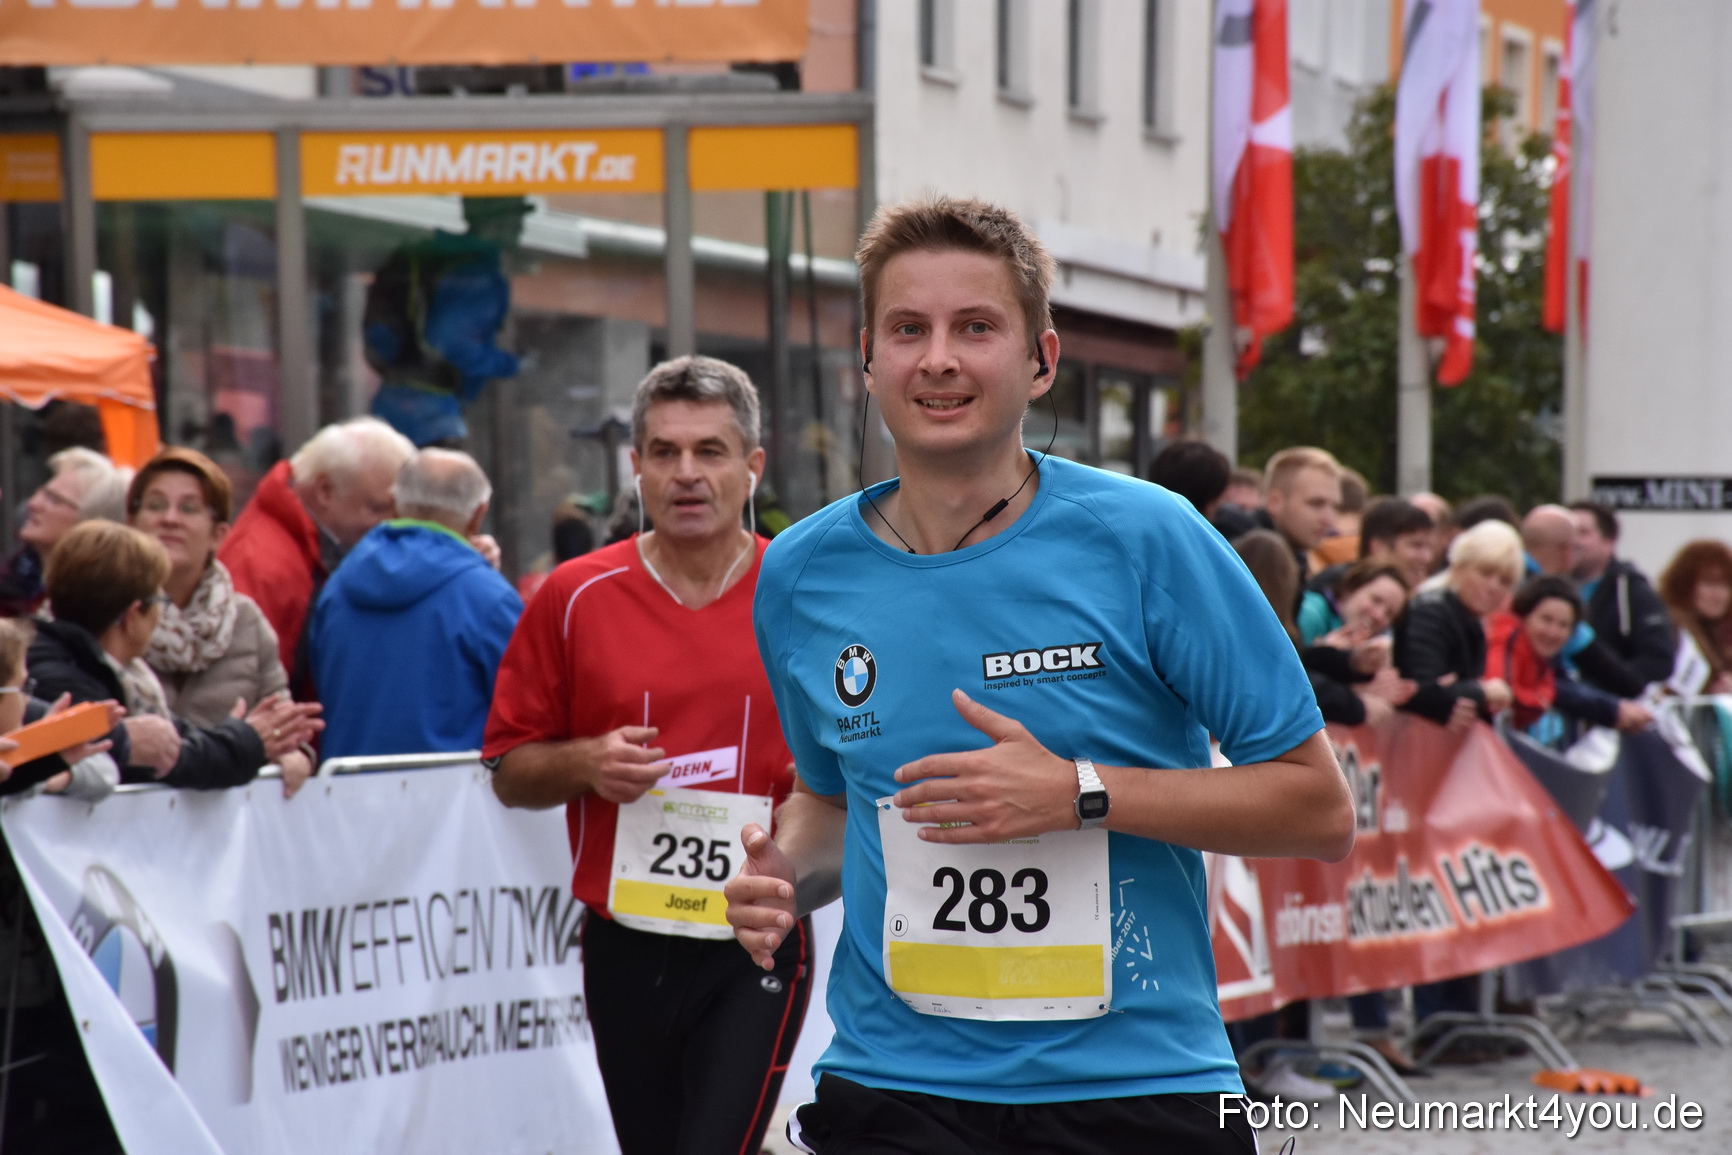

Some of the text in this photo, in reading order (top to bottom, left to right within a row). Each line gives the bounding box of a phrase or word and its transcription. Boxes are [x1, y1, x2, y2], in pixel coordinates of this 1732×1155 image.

[335, 141, 637, 185] RUNMARKT.DE
[837, 646, 873, 671] BMW
[984, 644, 1102, 678] BOCK
[984, 670, 1107, 690] inspired by smart concepts
[837, 711, 880, 733] PARTL
[839, 726, 882, 744] Neumarkt
[672, 760, 712, 778] DEHN
[649, 833, 731, 882] 235
[1441, 847, 1543, 921] Hits
[665, 894, 708, 912] Josef
[932, 866, 1051, 934] 283
[895, 920, 903, 931] D
[1120, 911, 1136, 938] 2017
